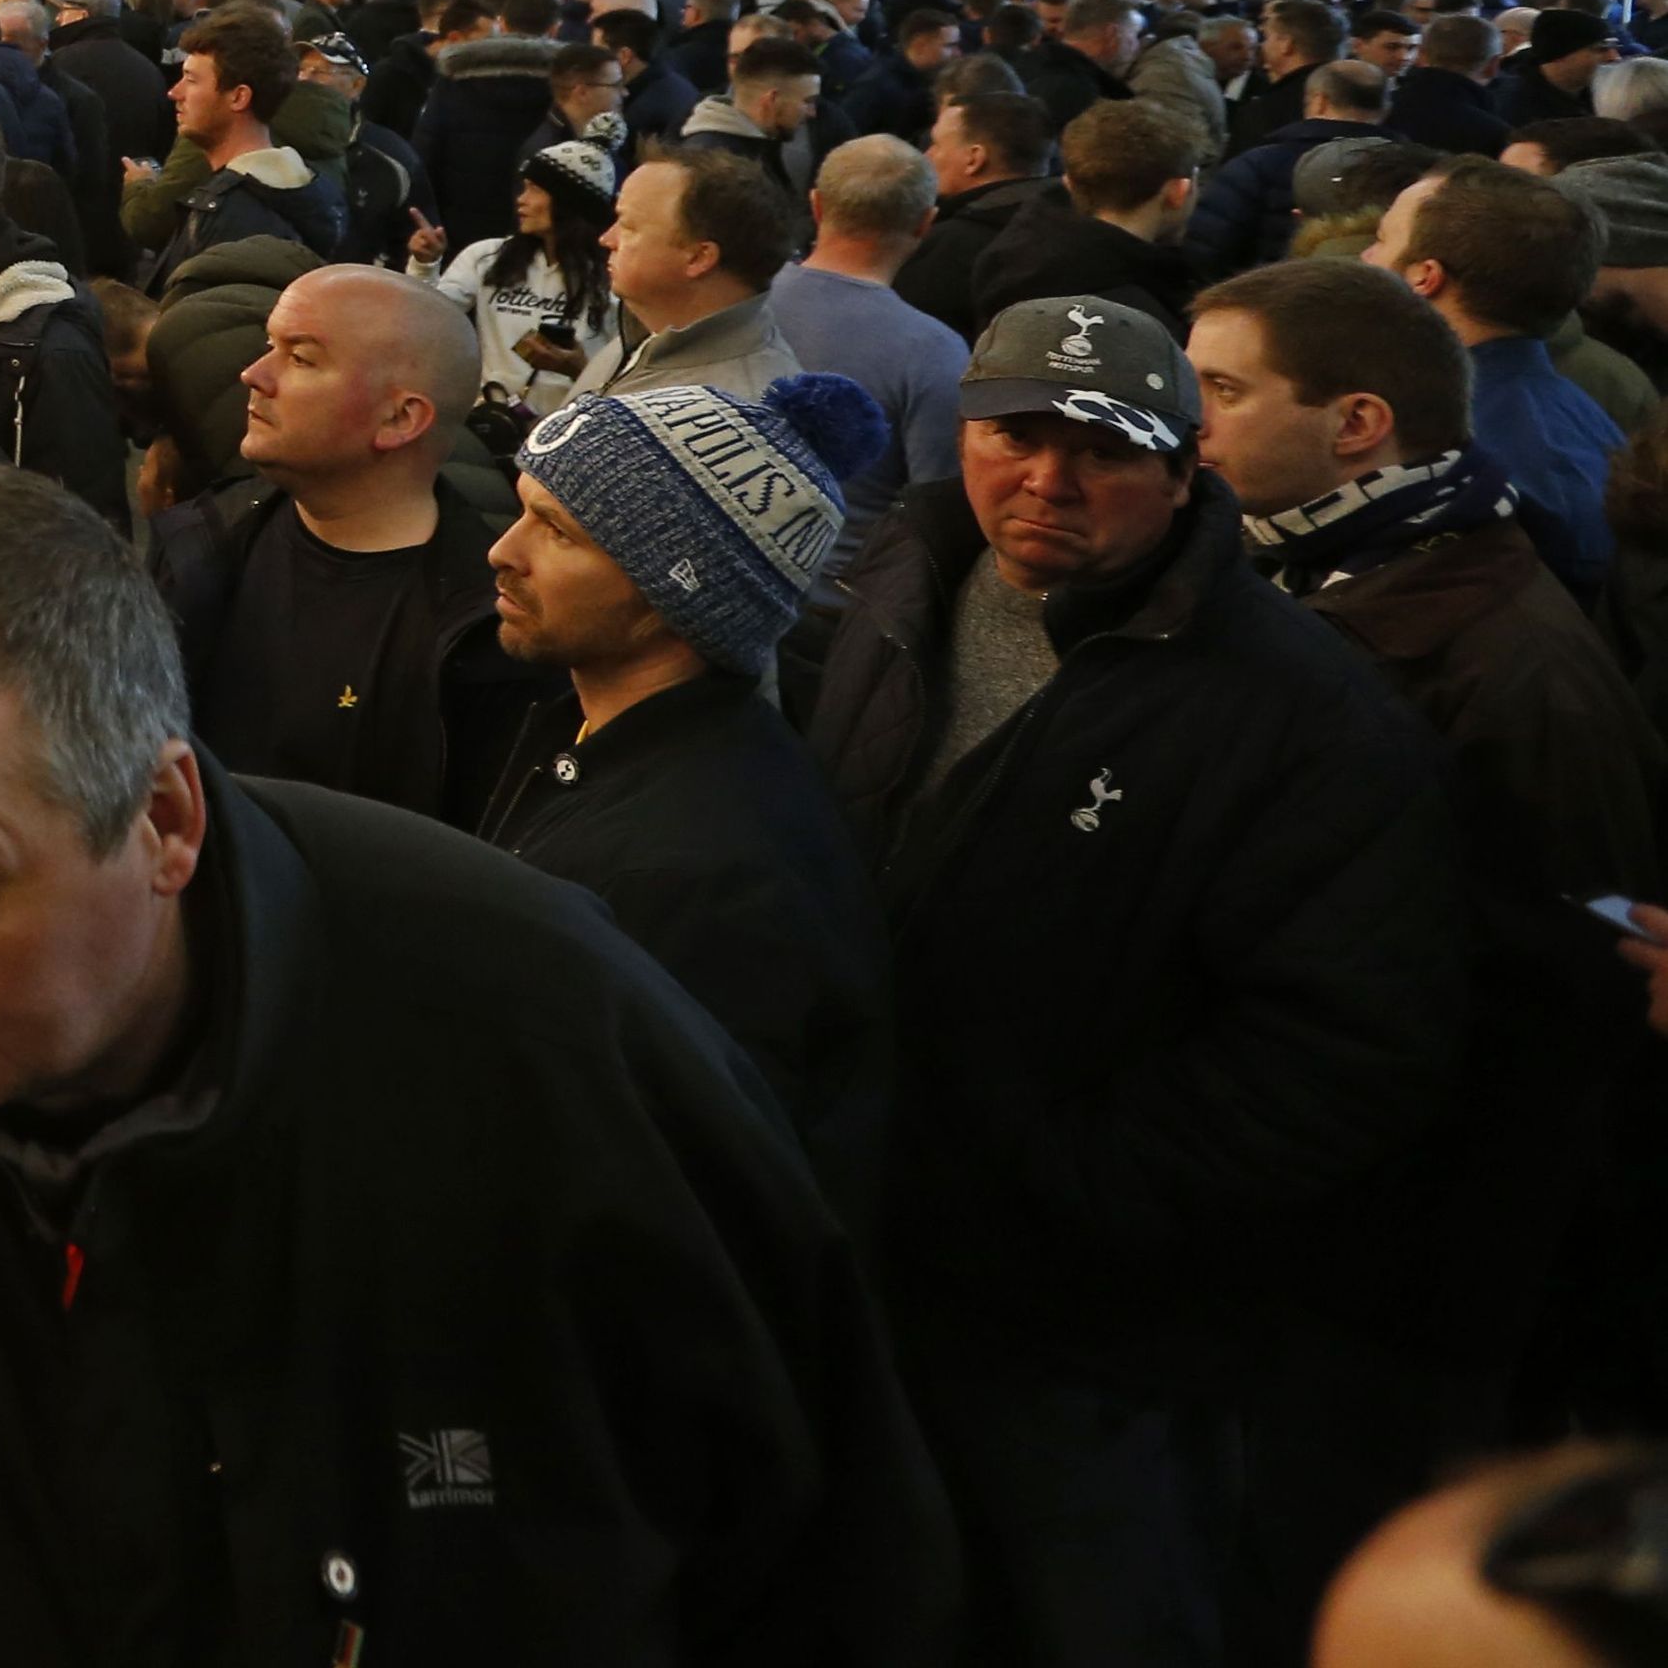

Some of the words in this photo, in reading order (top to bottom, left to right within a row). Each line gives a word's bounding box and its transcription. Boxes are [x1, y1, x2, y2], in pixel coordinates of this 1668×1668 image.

[1044, 350, 1102, 365] TOTTENHAM
[1047, 361, 1095, 374] HOTSPUR
[407, 1486, 495, 1509] karrimor
